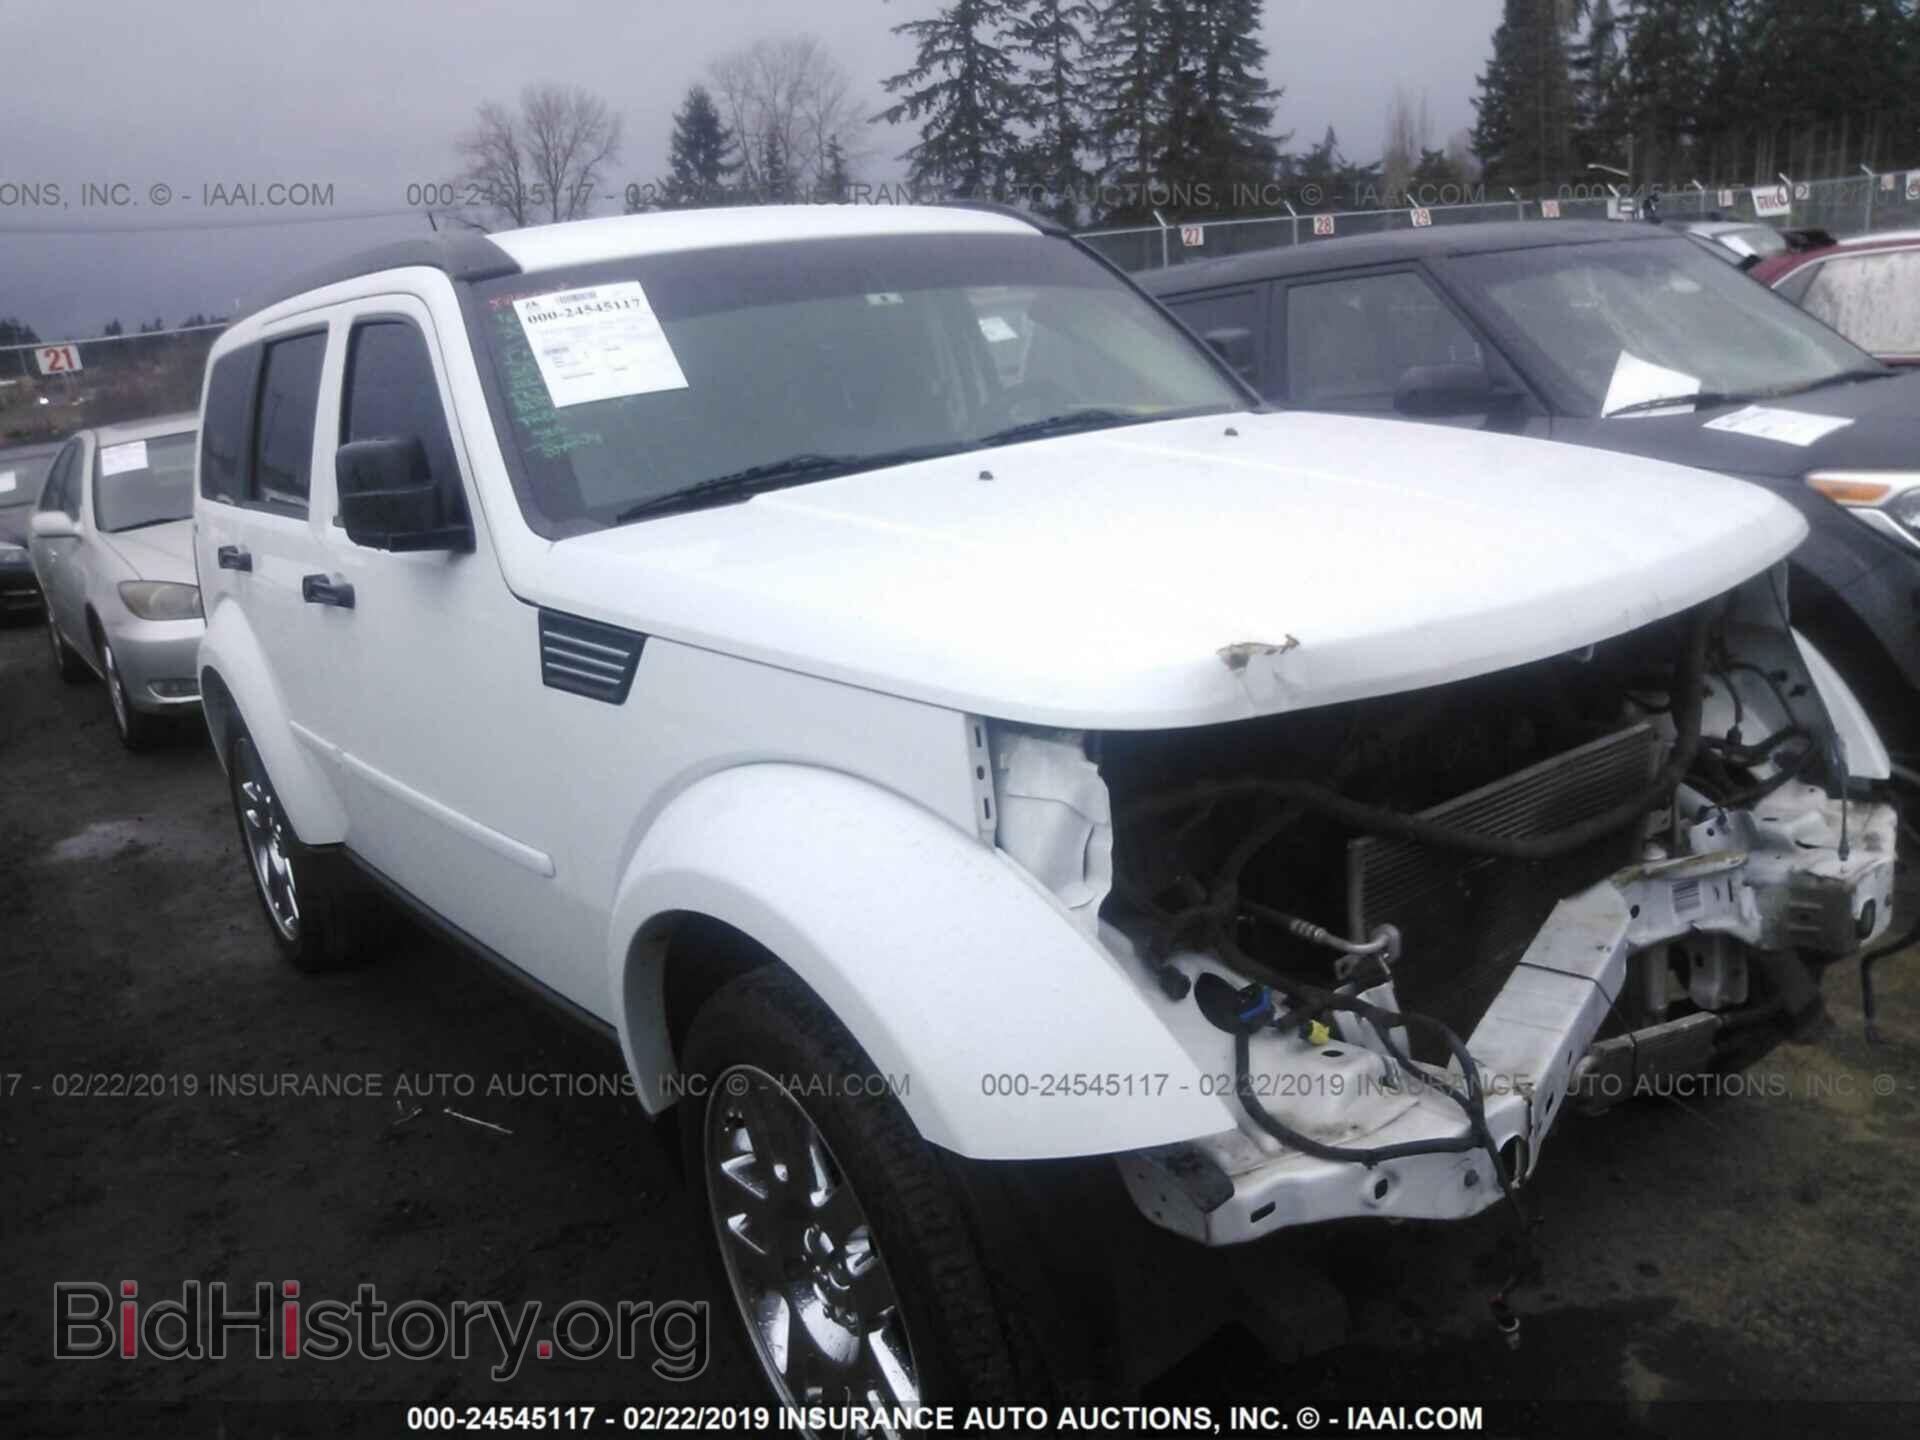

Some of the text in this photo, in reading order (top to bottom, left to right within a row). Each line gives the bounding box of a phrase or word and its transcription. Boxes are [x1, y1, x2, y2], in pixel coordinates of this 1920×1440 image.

[1316, 216, 1331, 234] 28
[1183, 228, 1200, 245] 27
[44, 348, 74, 371] 21
